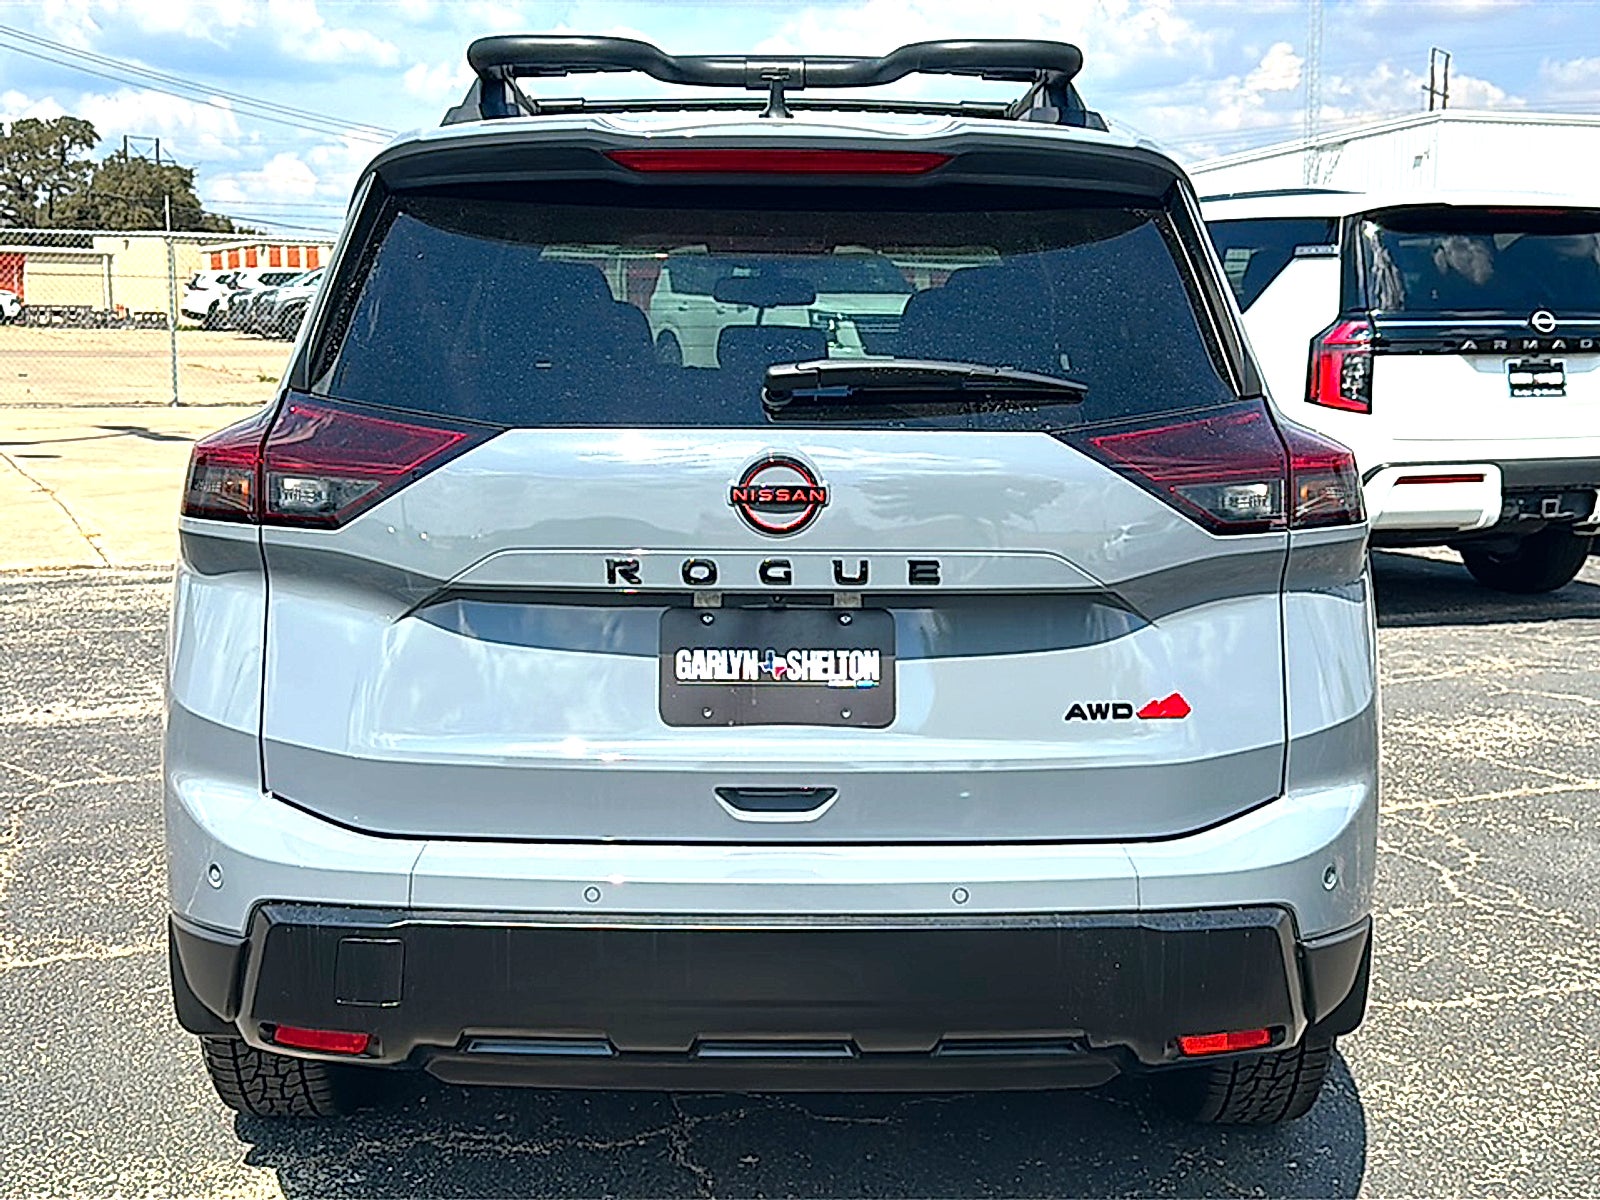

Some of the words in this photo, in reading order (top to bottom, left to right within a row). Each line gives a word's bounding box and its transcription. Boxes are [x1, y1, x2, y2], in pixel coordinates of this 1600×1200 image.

[1460, 339, 1600, 350] ARMAD
[732, 488, 825, 502] NISSAN
[605, 557, 942, 587] ROGUE
[675, 648, 759, 681] GARLYN
[786, 648, 880, 681] SHELTON
[1064, 702, 1134, 721] AWD
